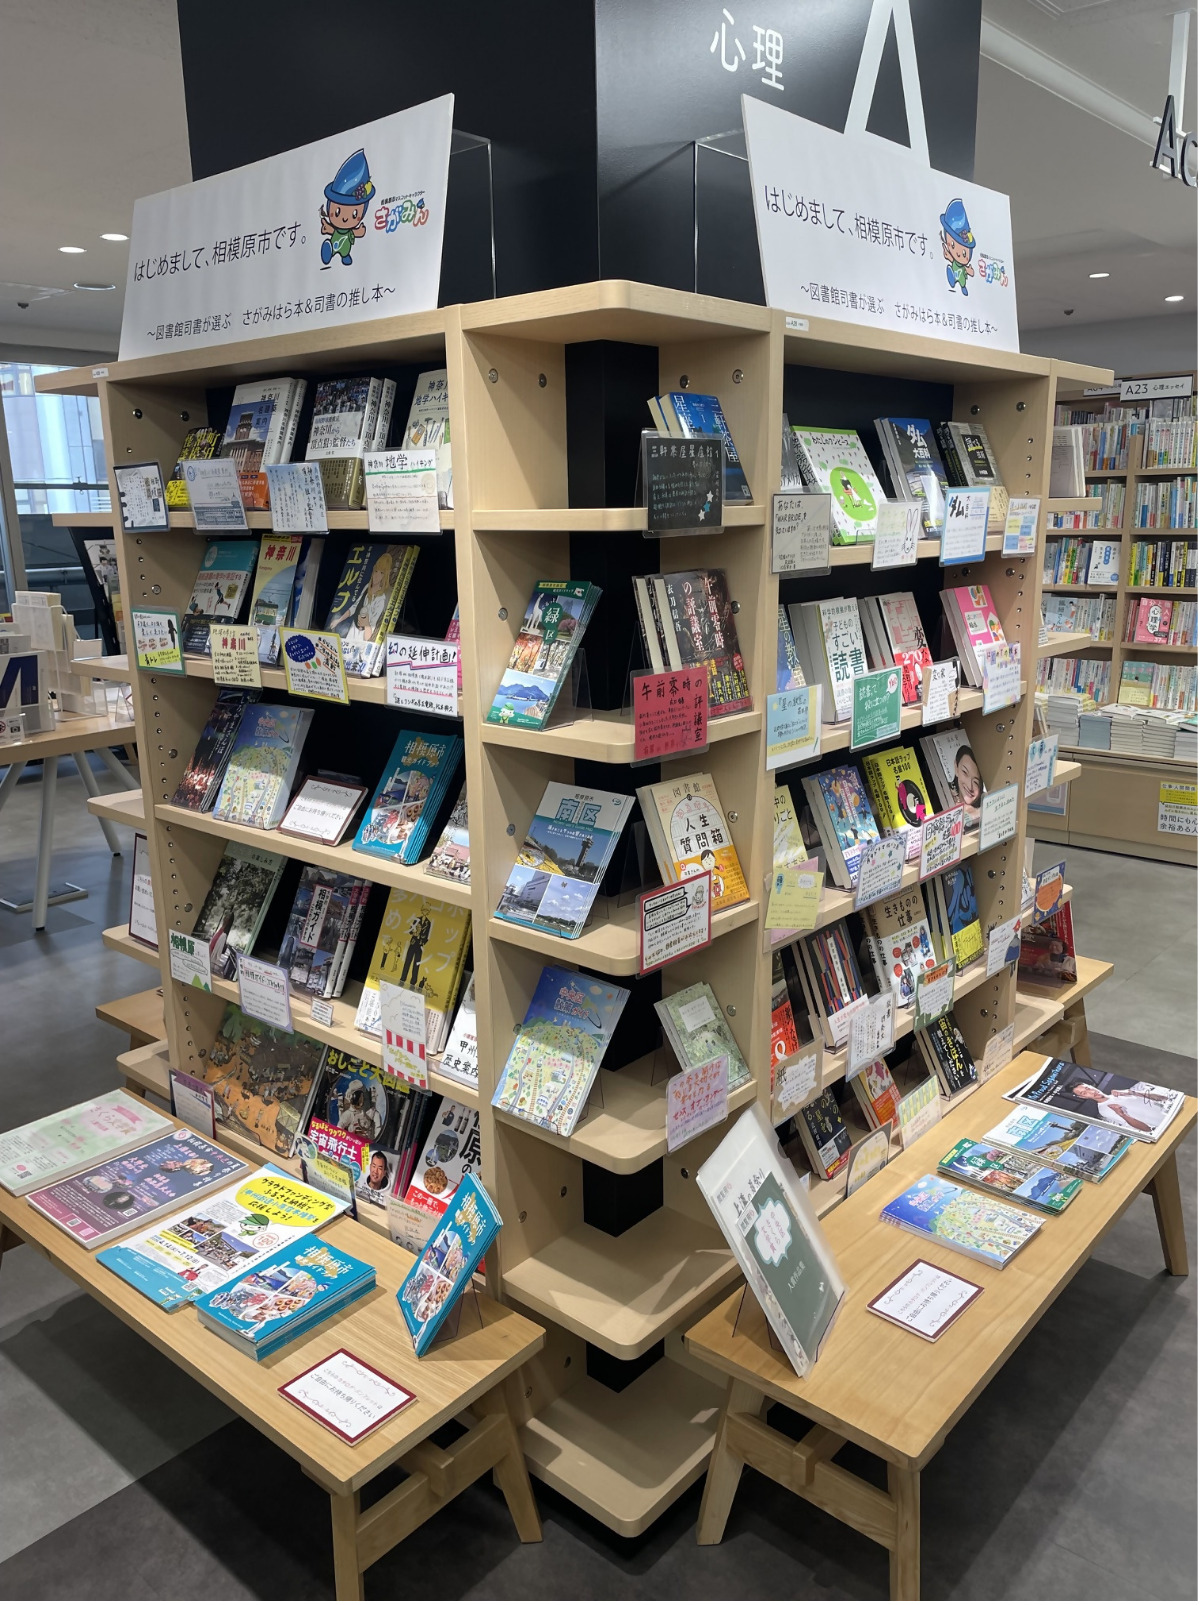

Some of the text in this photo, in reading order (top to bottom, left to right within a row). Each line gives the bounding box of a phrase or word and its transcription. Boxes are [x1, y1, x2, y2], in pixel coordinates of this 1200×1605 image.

[710, 10, 785, 91] 心理
[844, 0, 930, 167] A
[374, 199, 429, 233] さがみん
[764, 185, 934, 260] はじめまして、相模原市です。
[133, 221, 307, 282] はじめまして、相模原市です。
[978, 258, 1009, 288] さがみん
[800, 283, 884, 315] ～図書館司書が選ぶ
[147, 312, 232, 341] ～図書館司書が選ぶ
[1125, 383, 1148, 395] A23
[1152, 383, 1185, 391] 心理エッセイ
[385, 454, 408, 470] 地学
[264, 544, 298, 561] 神奈川
[331, 545, 365, 613] エルフ
[544, 607, 561, 641] 緑区
[683, 581, 705, 651] の評議室
[703, 576, 725, 650] 午前零時
[832, 618, 854, 632] 子どもの
[1149, 607, 1161, 633] 心理学
[221, 637, 246, 651] 神奈川
[832, 632, 860, 651] すごい
[833, 647, 865, 682] 読書
[902, 650, 922, 665] 270
[641, 676, 703, 702] 午前零時の
[693, 695, 703, 743] 評議室
[404, 740, 446, 758] 相模原市
[885, 752, 911, 767] 日本語ラップ
[672, 781, 702, 799] 図書館
[554, 798, 602, 828] 南区
[685, 813, 710, 833] 人生
[680, 828, 723, 855] 質問箱
[884, 895, 918, 919] 生きものの
[897, 912, 913, 928] 仕事
[170, 933, 195, 956] 相模原
[559, 986, 585, 1004] 中央区
[309, 1129, 358, 1161] 宇宙飛行士
[261, 1177, 334, 1211] クラウドファンディング型
[263, 1188, 315, 1211] ふるさと納税で
[460, 1192, 487, 1236] 相模原市
[303, 1245, 354, 1276] 相模原市
[310, 1373, 376, 1419] ご自由にお持ち帰りください
